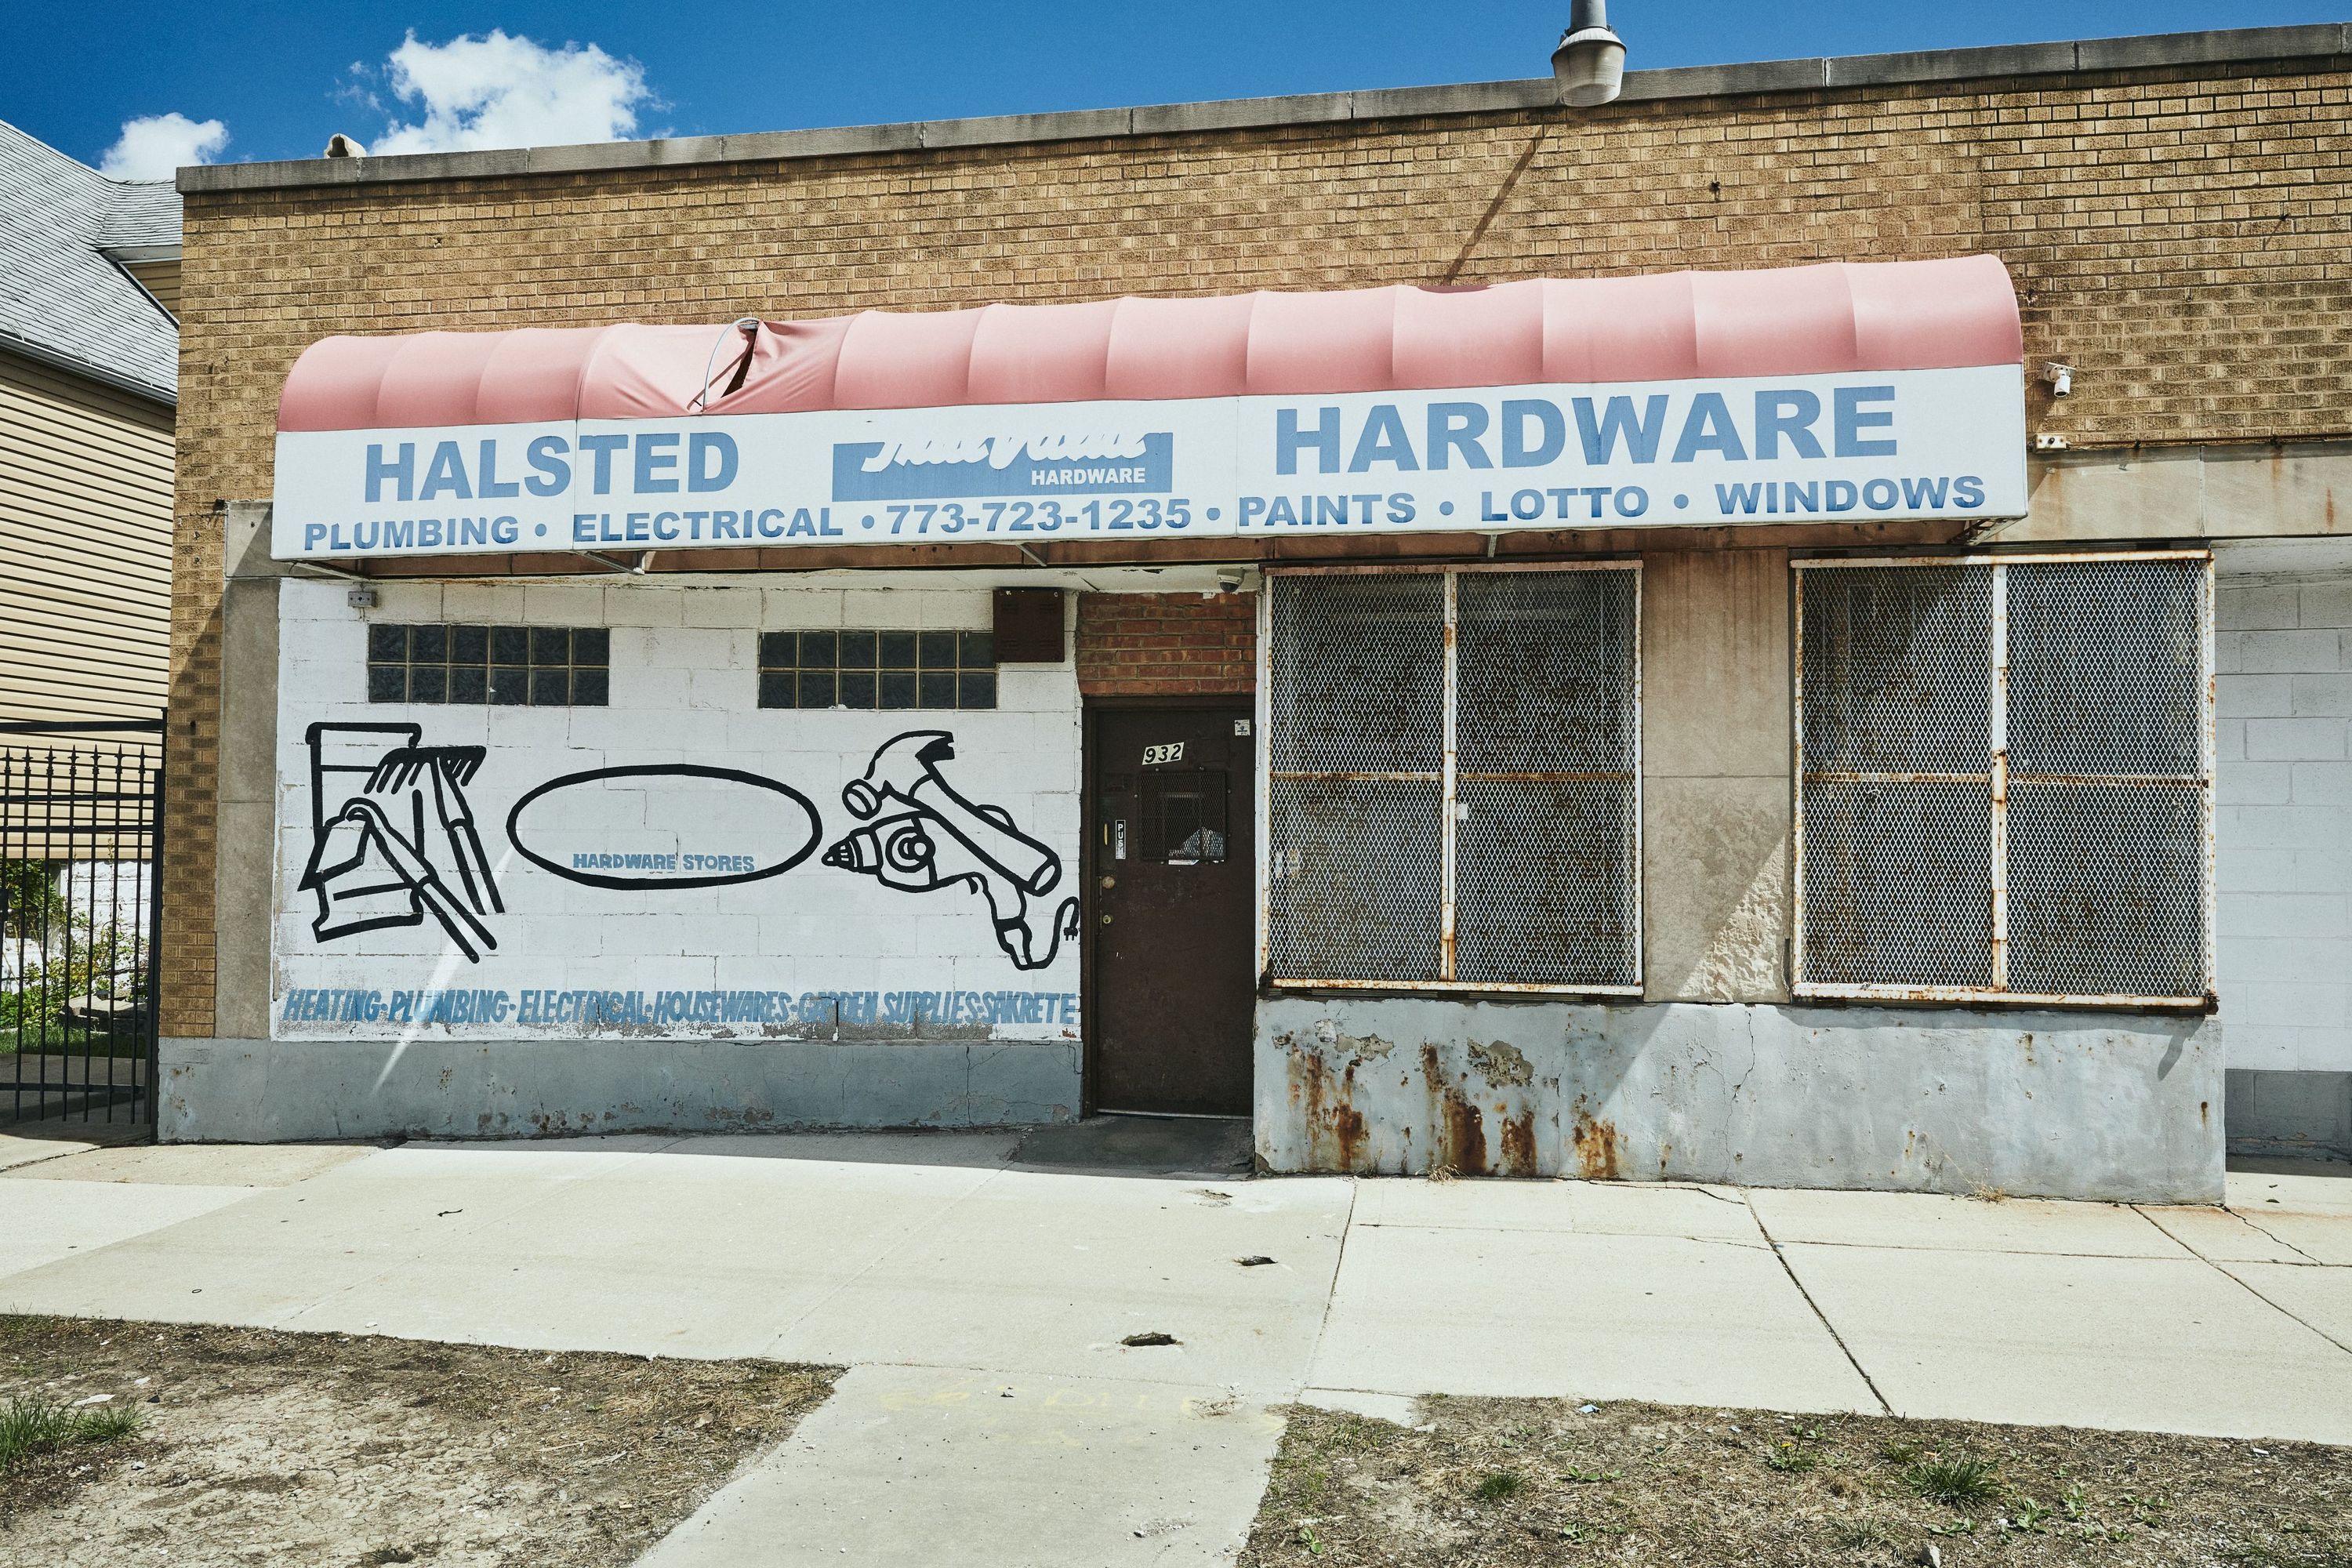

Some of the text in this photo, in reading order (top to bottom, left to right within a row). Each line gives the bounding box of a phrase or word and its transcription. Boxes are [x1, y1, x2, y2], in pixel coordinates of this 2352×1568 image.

[365, 386, 1897, 503] HALSTED HARDWARE
[1031, 467, 1146, 486] HARDWARE
[304, 476, 1986, 551] PLUMBING ELECTRICAL 773-723-1235 PAINTS LOTTO WINDOWS
[1144, 743, 1182, 764] 932
[573, 853, 755, 872] HARDWARE STORES
[282, 989, 382, 1022] HEATING
[389, 989, 510, 1023] PLUMBING
